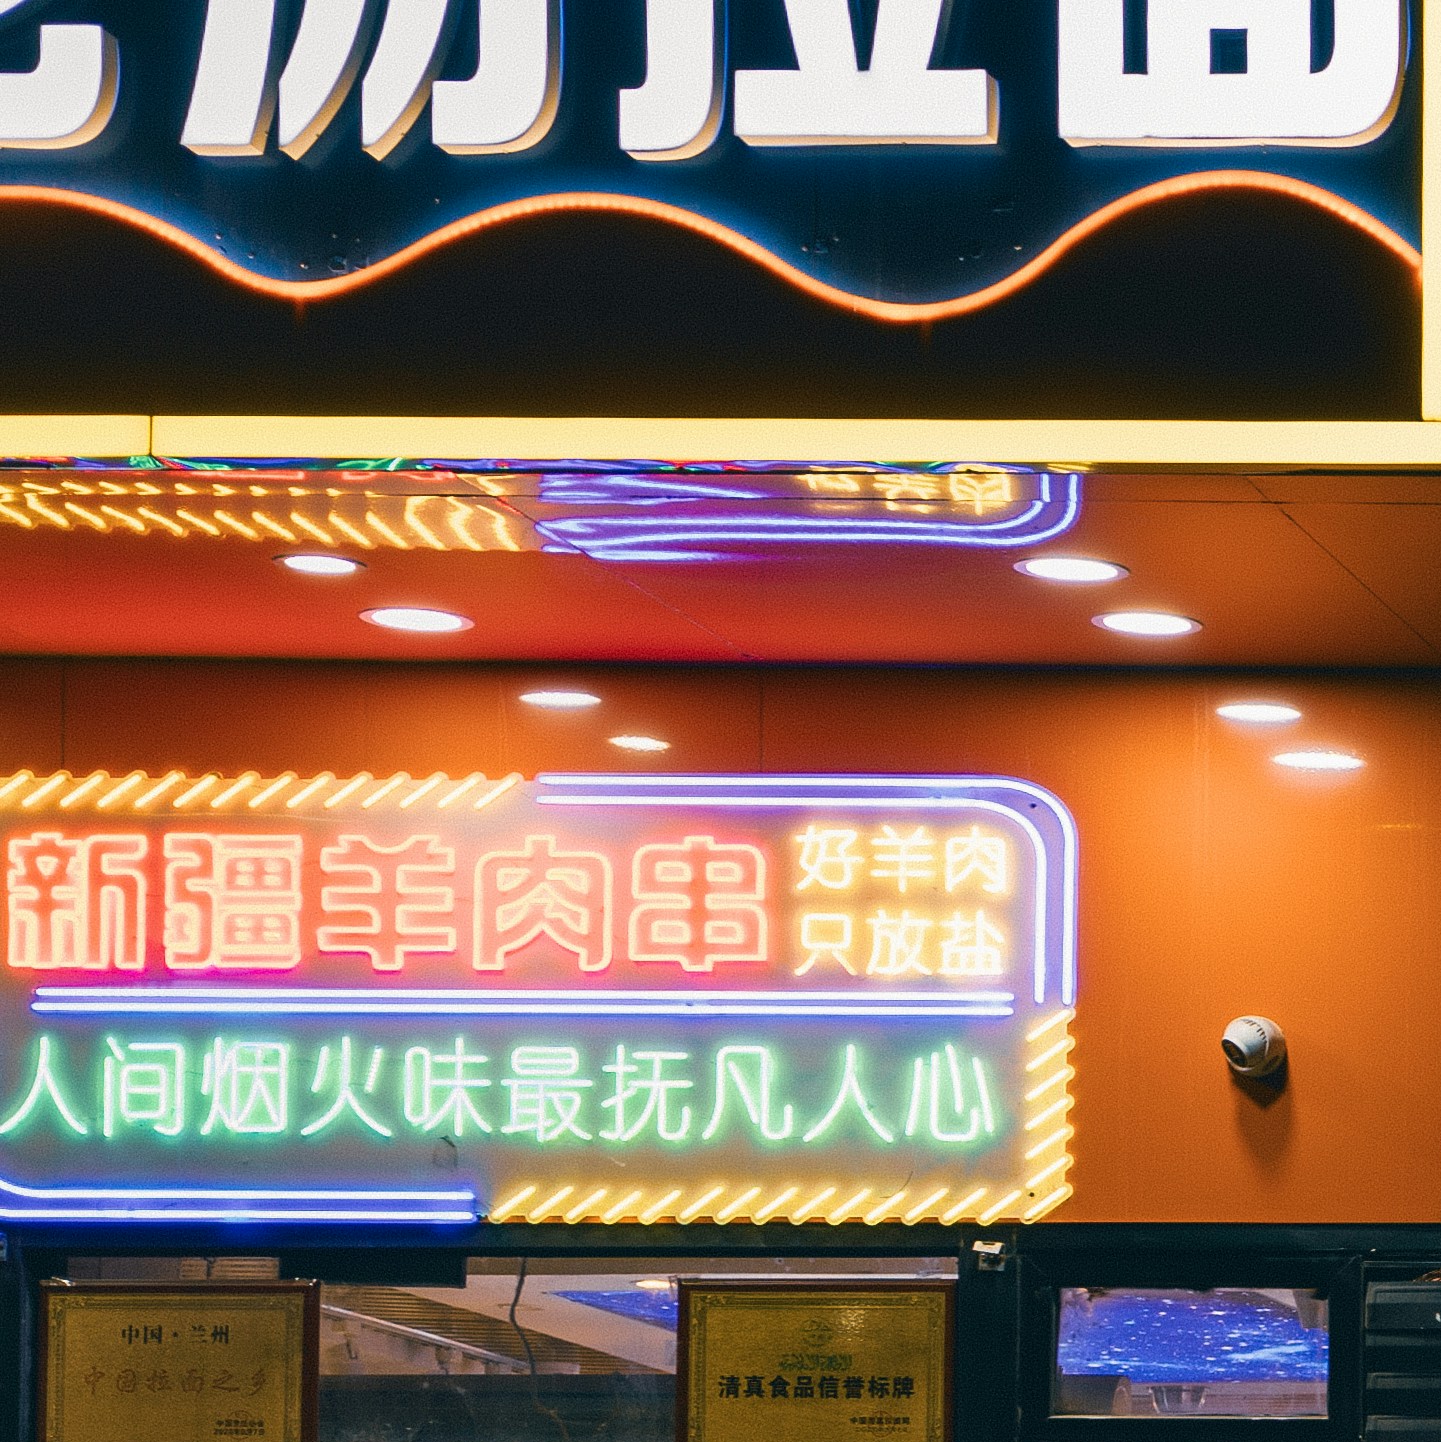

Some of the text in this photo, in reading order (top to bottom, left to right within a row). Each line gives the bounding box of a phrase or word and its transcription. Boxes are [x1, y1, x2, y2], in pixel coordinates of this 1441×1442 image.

[795, 824, 1008, 895] 好羊肉
[5, 833, 769, 974] 新疆羊肉串
[795, 908, 1006, 977] 只放盐
[1, 1036, 996, 1144] 人间烟火味最抚凡人心
[84, 1366, 278, 1396] 中国拉面之乡
[718, 1375, 915, 1400] 清真食品信誉标牌
